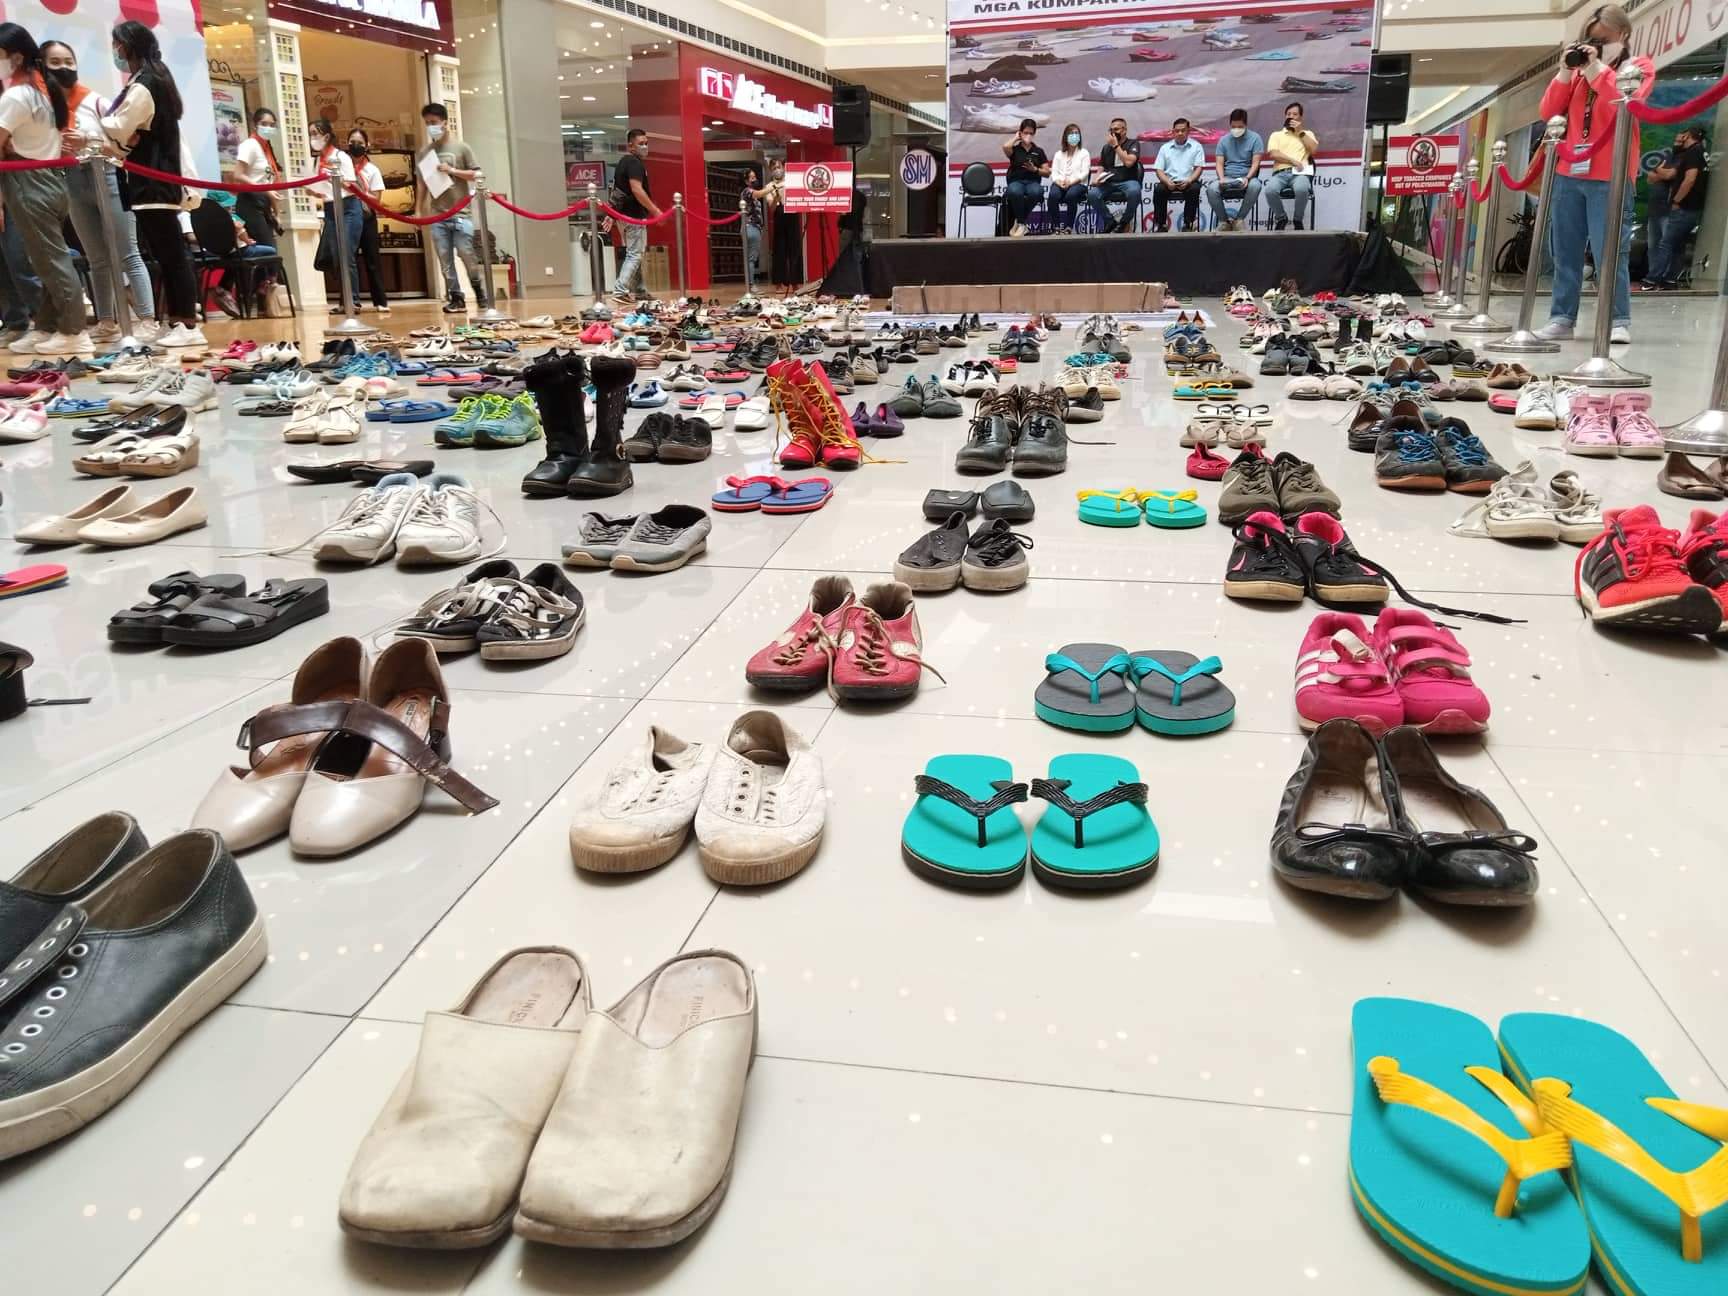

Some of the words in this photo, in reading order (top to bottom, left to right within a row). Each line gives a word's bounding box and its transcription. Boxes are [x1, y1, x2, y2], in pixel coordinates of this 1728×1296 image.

[974, 2, 1020, 14] MGA
[575, 169, 597, 180] ACE
[903, 153, 932, 184] SM
